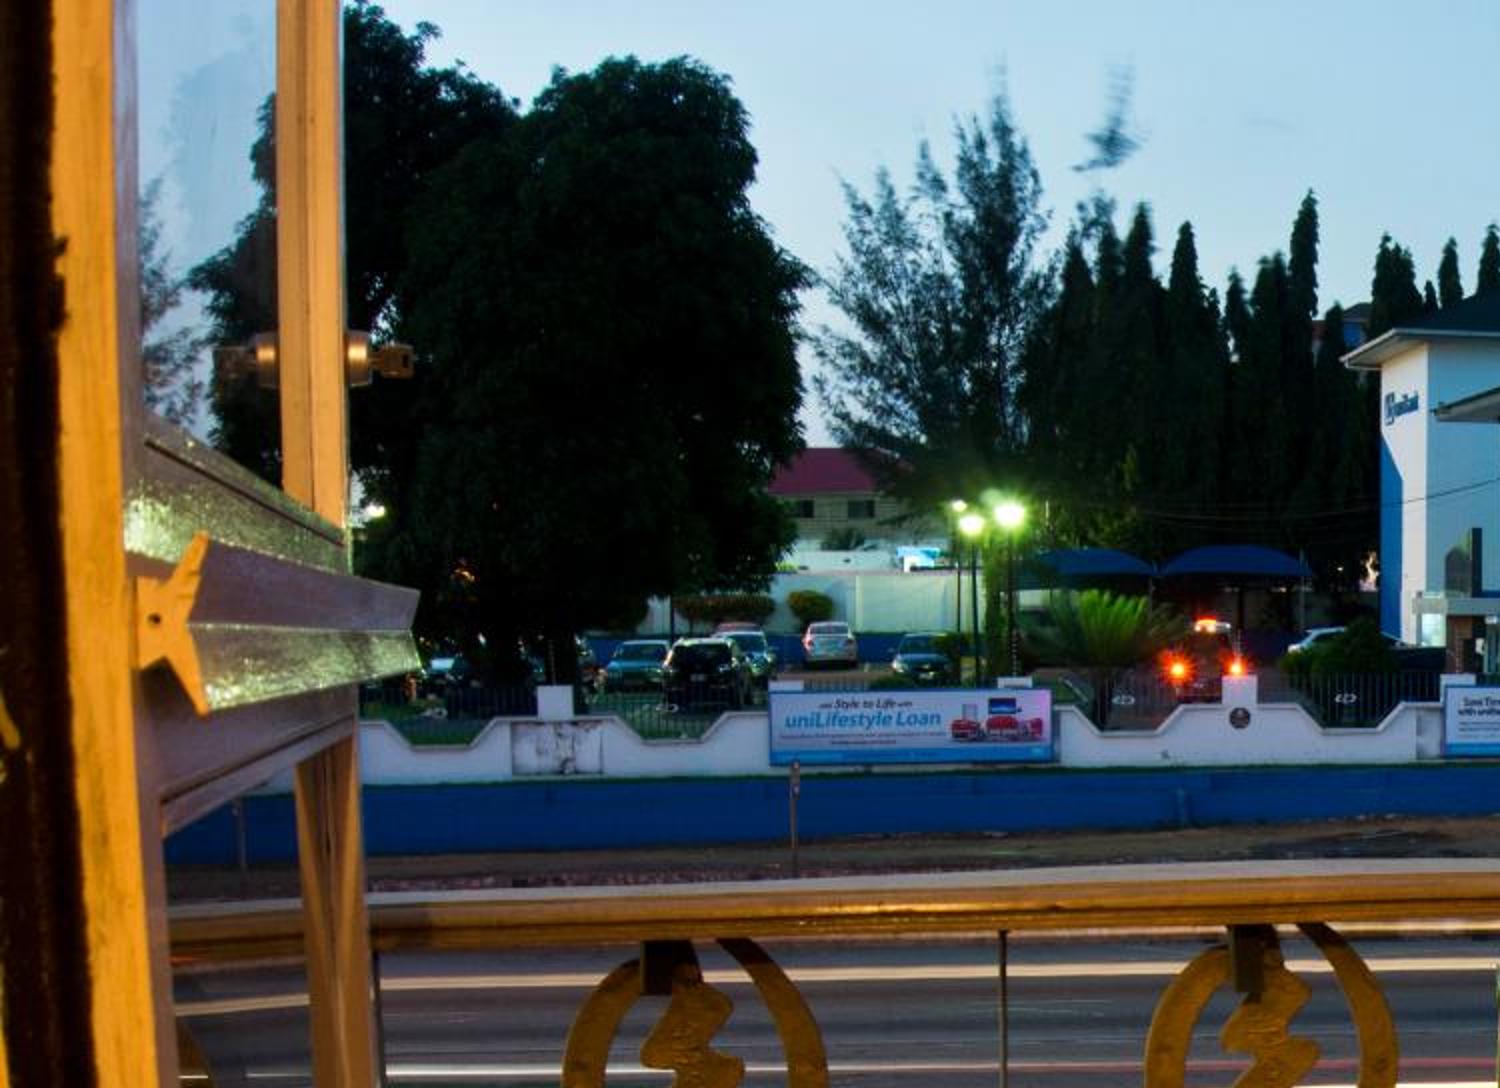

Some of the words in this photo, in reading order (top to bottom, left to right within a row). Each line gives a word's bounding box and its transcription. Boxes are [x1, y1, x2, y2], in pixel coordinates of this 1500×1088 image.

[833, 698, 860, 709] Style
[876, 698, 897, 709] Life
[784, 710, 892, 729] uniLifestyle
[895, 711, 941, 727] Loan
